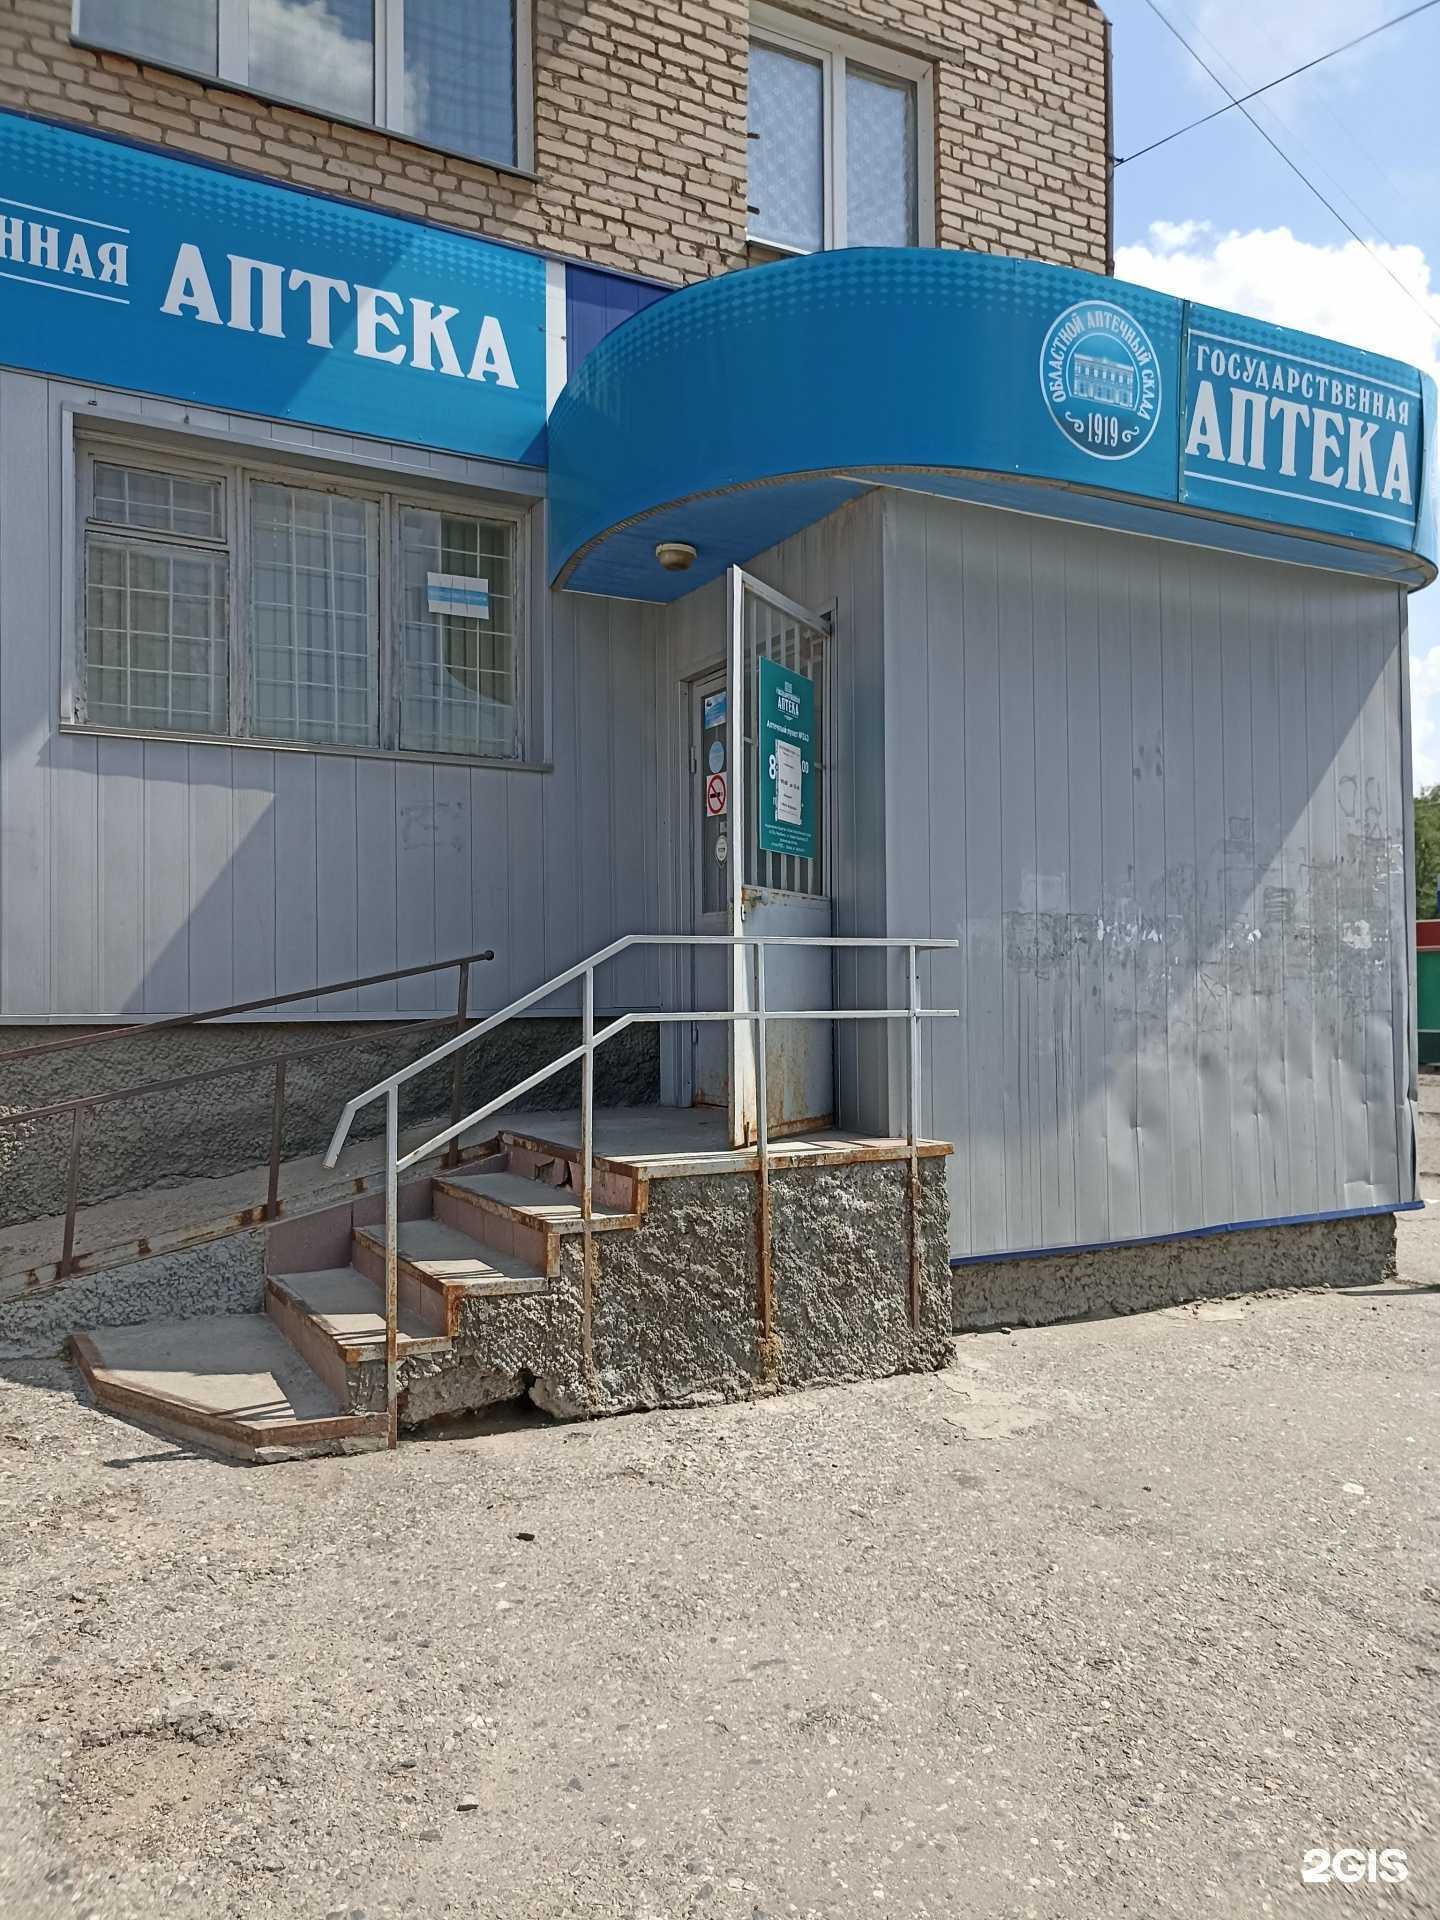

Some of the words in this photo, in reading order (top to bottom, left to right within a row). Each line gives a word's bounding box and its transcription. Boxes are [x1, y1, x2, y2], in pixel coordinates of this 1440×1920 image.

[159, 243, 519, 389] АПТЕКА
[1048, 313, 1086, 403] ОБЛАСТНОЙ
[1087, 310, 1152, 367] АПТЕЧНЫЙ
[1136, 368, 1156, 420] СКЛАД
[1196, 344, 1410, 427] ГОСУДАРСТВЕННАЯ
[1087, 412, 1119, 447] 1919
[1184, 380, 1413, 506] АПТЕКА
[777, 695, 800, 717] АПТЕКА
